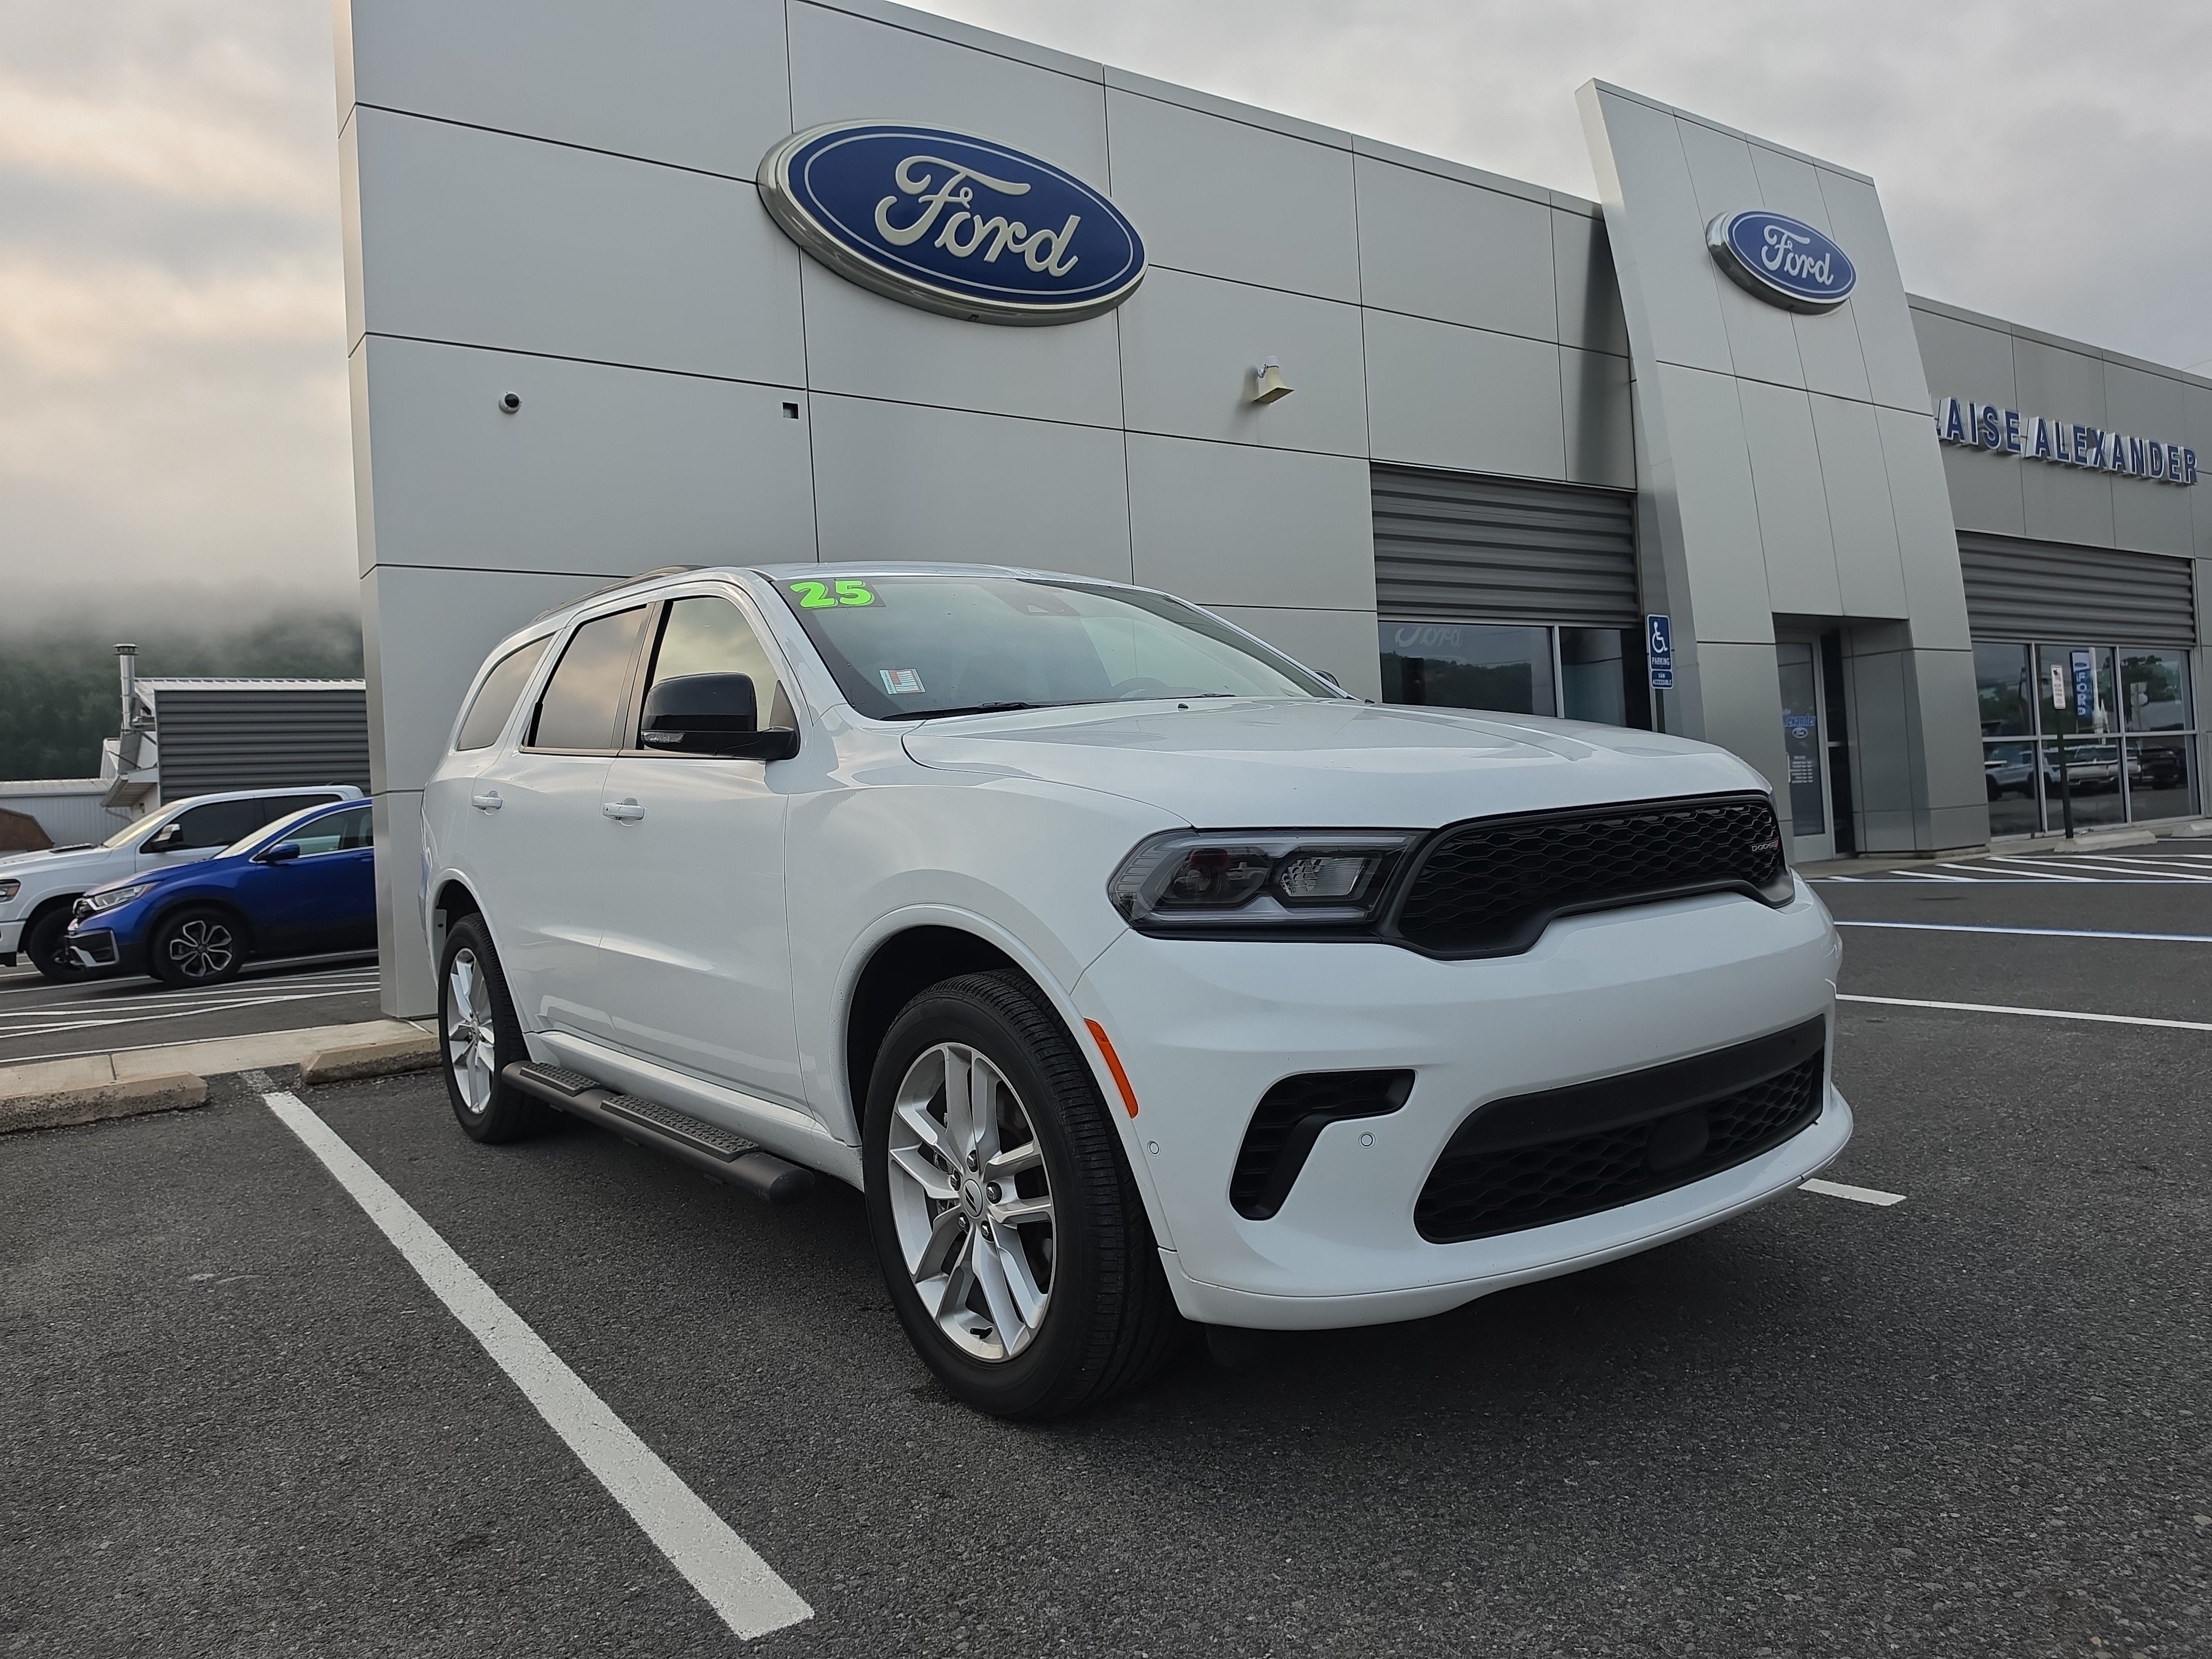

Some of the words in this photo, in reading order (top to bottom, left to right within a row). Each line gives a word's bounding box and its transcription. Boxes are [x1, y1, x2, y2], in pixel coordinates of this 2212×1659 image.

[874, 155, 1081, 277] Ford
[1761, 225, 1834, 286] Ford
[1936, 396, 2022, 454] AISE
[2026, 416, 2198, 485] ALEXANDER
[790, 581, 875, 608] 25
[1651, 657, 1670, 666] PARKING
[2076, 672, 2087, 716] FORD
